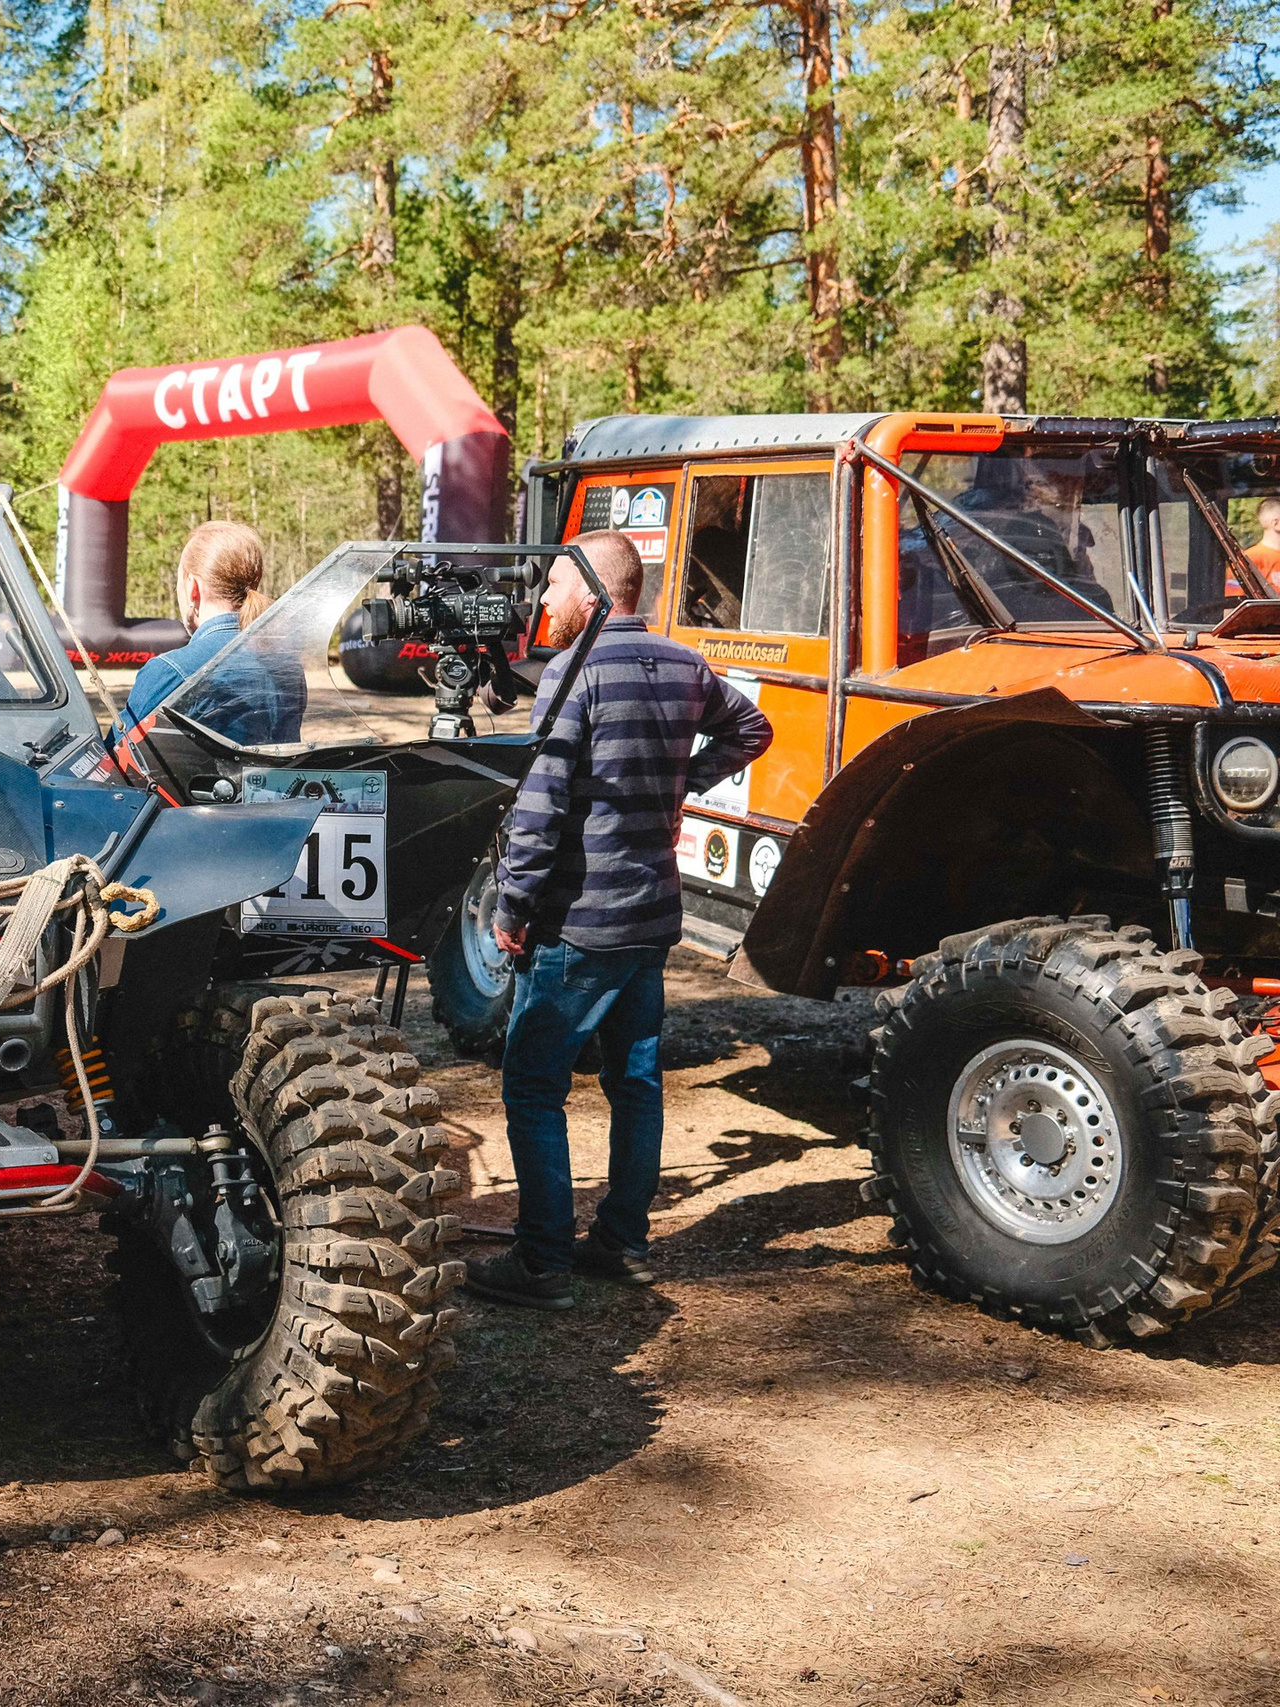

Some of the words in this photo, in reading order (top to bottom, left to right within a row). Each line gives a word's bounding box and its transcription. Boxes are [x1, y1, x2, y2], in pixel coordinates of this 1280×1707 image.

[154, 351, 322, 429] СТАРТ
[398, 643, 439, 659] ДО
[698, 638, 788, 663] #avtokotdosaaf
[263, 832, 378, 901] 15
[256, 922, 277, 931] NEO
[350, 924, 372, 933] NEO
